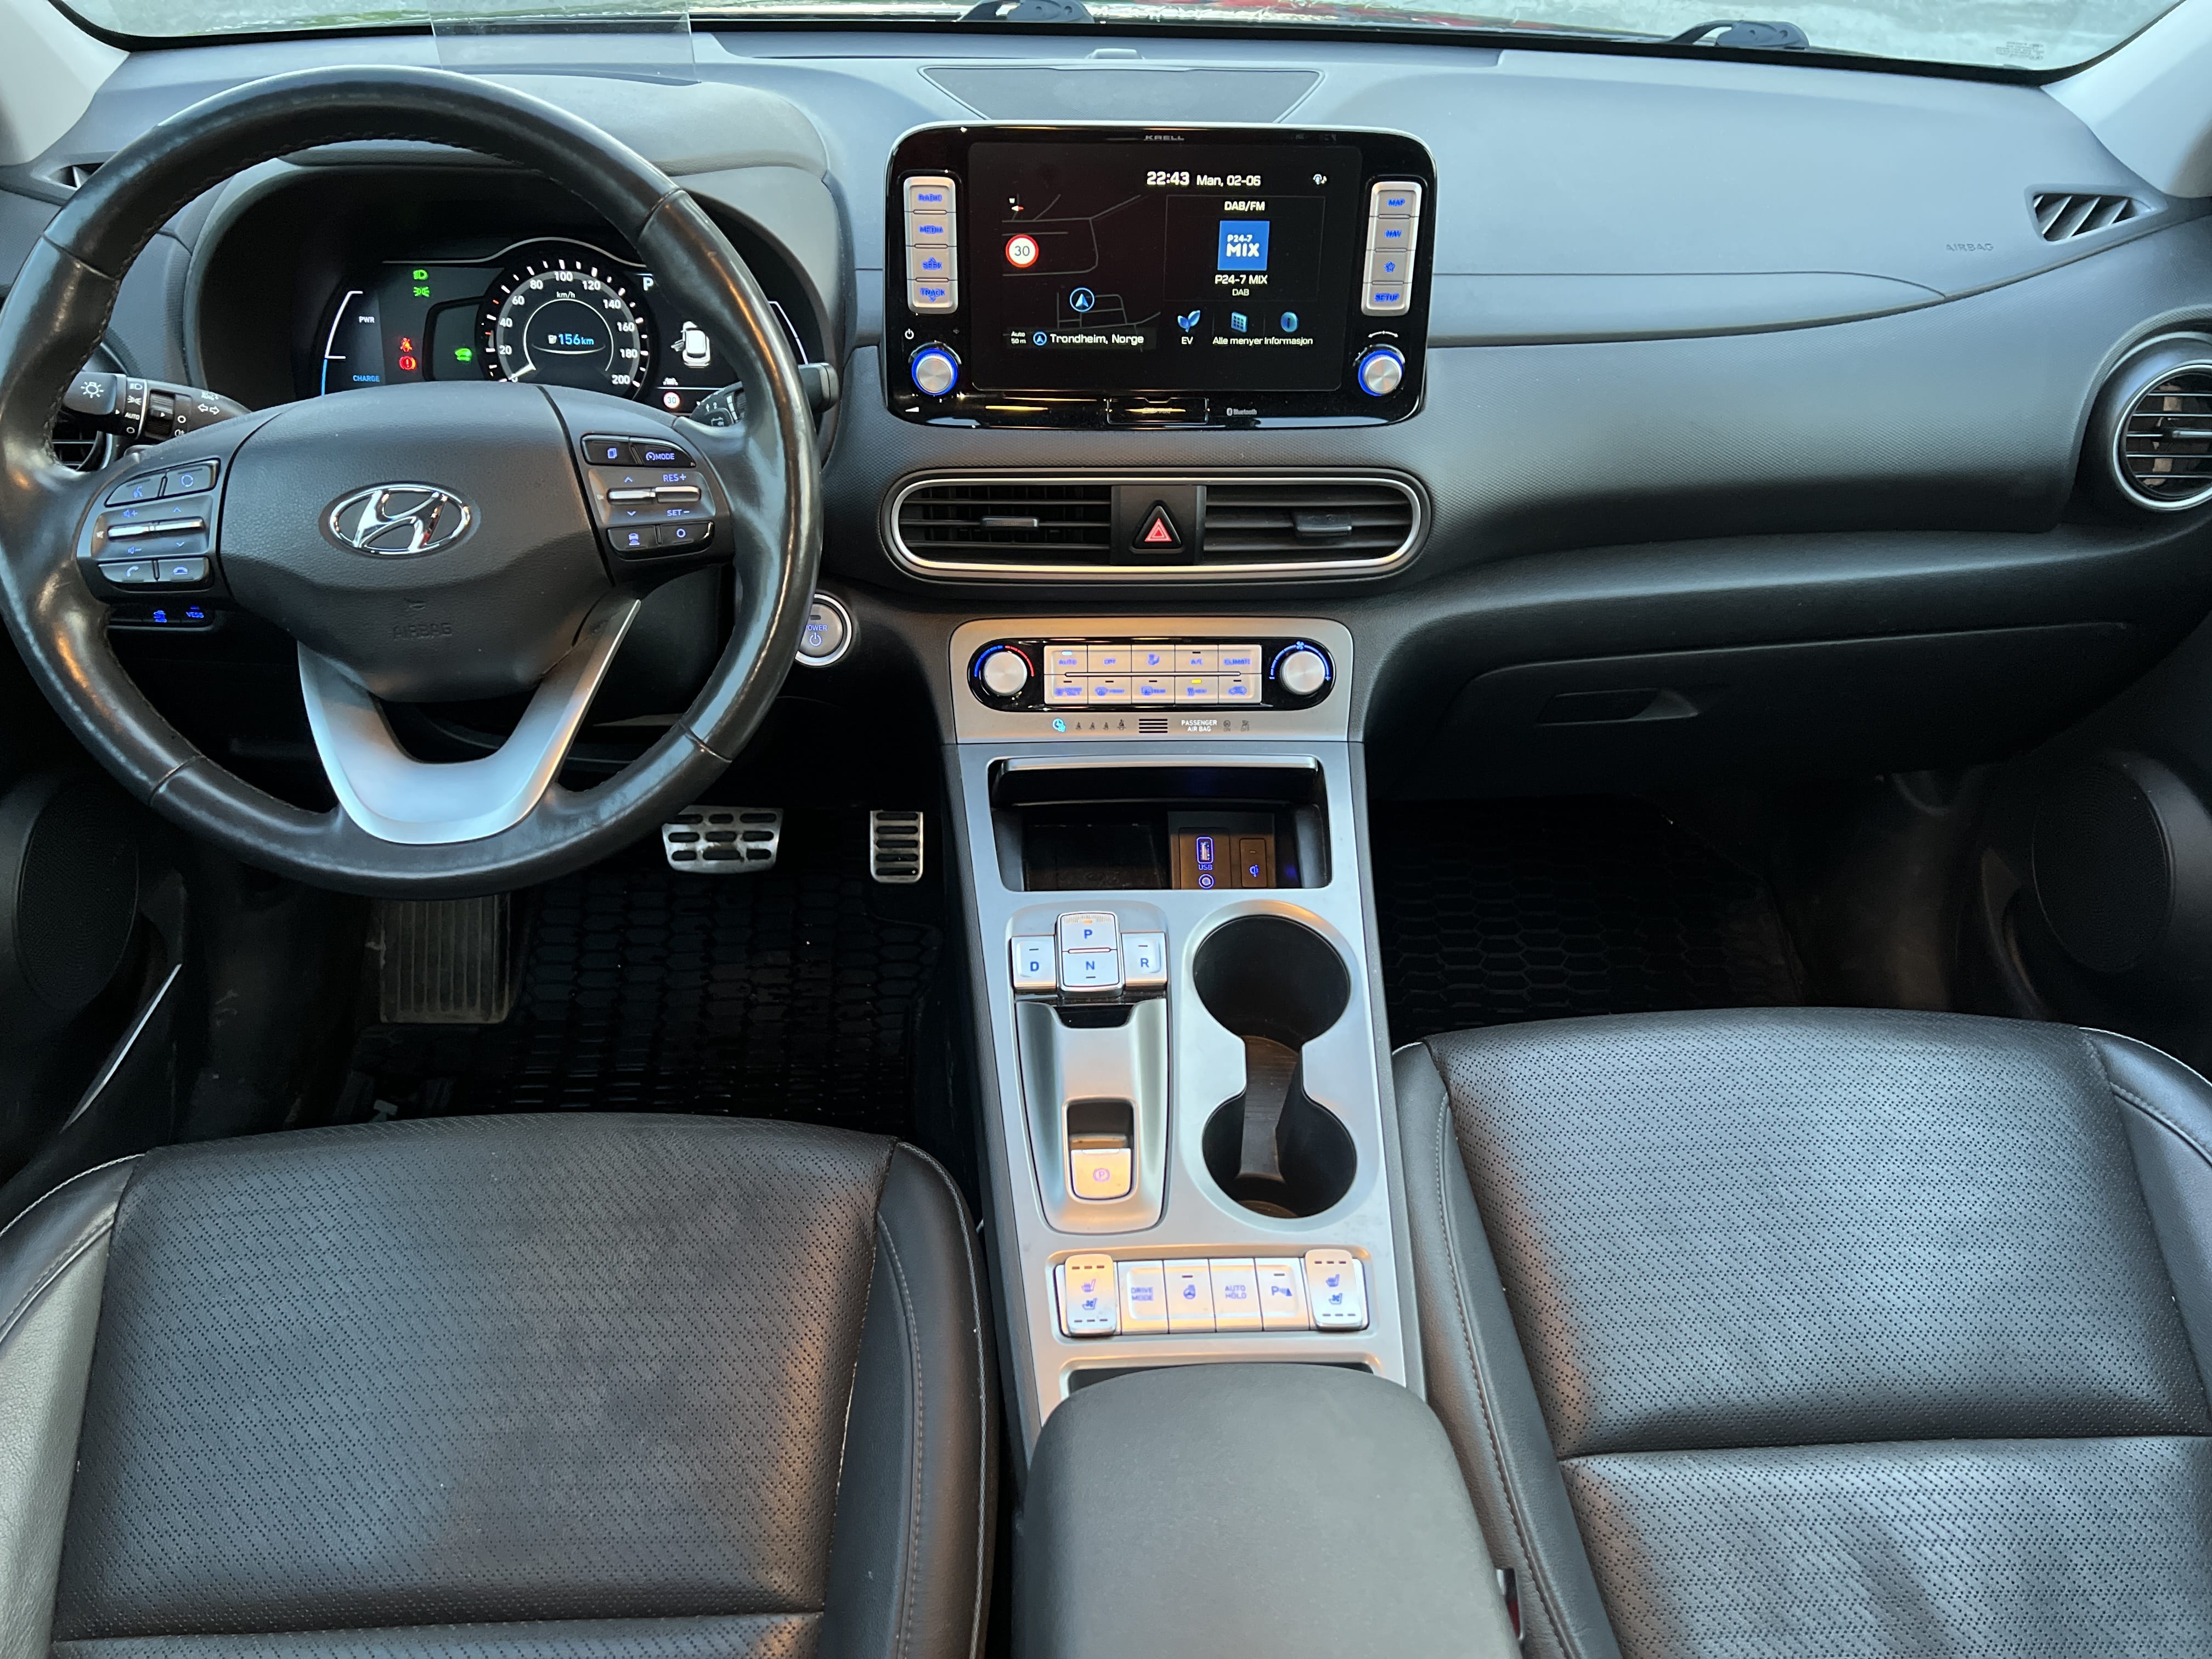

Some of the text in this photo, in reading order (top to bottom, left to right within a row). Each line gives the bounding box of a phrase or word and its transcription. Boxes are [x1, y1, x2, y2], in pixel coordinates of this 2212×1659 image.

[1147, 171, 1261, 187] 22:43 Man, 02-06
[918, 194, 943, 202] RADIO
[1224, 201, 1265, 211] DAB/FM
[918, 225, 944, 234] MEDIA
[1384, 229, 1402, 238] NAV
[1227, 234, 1252, 242] P24-7
[1014, 246, 1030, 256] 30
[1226, 242, 1260, 257] MIX
[1946, 243, 1994, 251] AIRBAG
[922, 262, 943, 270] SEEK
[555, 271, 573, 281] 100
[1215, 275, 1268, 284] P24-7 MIX
[530, 280, 544, 290] 80
[582, 281, 601, 290] 120
[643, 278, 653, 291] P
[919, 288, 945, 296] TRACK
[512, 296, 524, 305] 60
[1374, 293, 1400, 302] SETUP
[603, 299, 621, 309] 140
[499, 318, 512, 328] 40
[617, 322, 635, 331] 160
[1050, 334, 1144, 346] Trondheim, Norge
[1181, 336, 1193, 345] EV
[1212, 337, 1228, 345] Alle
[1264, 337, 1313, 347] Informasjon
[499, 345, 512, 355] 20
[620, 349, 638, 358] 180
[612, 375, 630, 384] 200
[125, 411, 140, 420] AUTO
[1084, 929, 1092, 939] P
[1030, 961, 1039, 972] D
[1086, 961, 1095, 970] N
[1141, 958, 1149, 967] R
